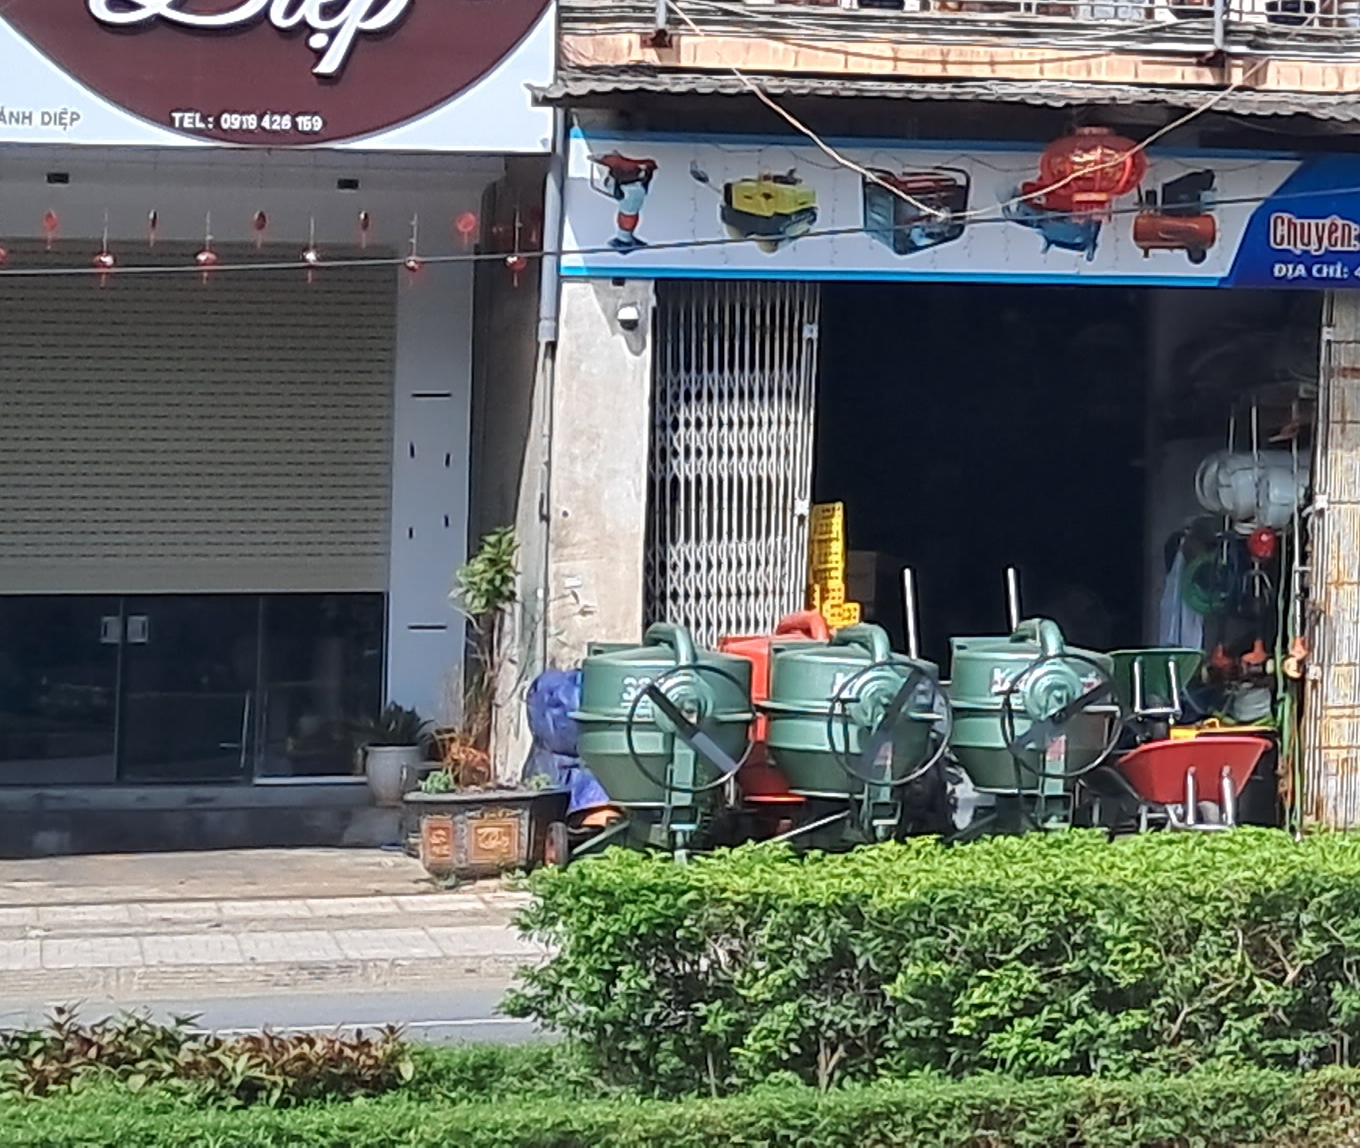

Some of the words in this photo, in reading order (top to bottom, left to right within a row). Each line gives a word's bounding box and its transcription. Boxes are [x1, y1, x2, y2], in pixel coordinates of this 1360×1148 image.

[40, 107, 81, 131] DIỆP
[171, 112, 214, 129] TEL:
[1270, 212, 1360, 256] Chuyên:
[1273, 263, 1306, 281] ĐỊA
